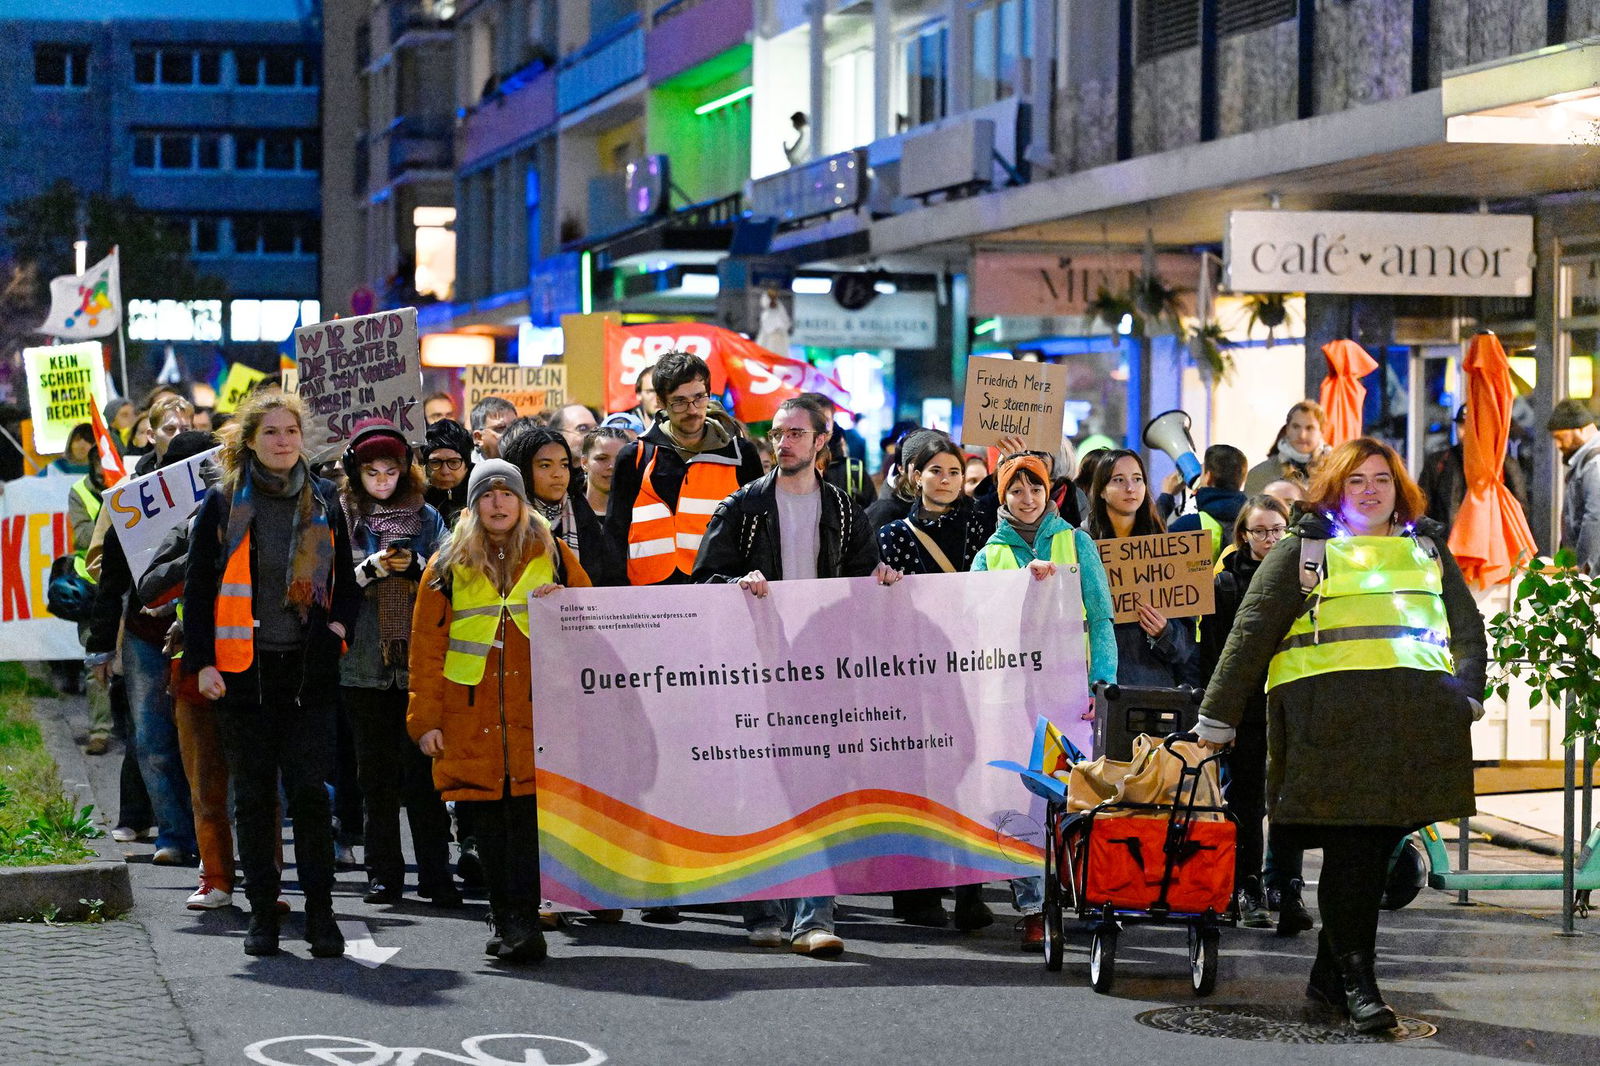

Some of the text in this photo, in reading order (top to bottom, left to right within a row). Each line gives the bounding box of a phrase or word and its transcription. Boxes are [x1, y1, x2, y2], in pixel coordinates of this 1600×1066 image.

[1251, 233, 1510, 278] café amor
[49, 354, 78, 370] KEIN
[40, 369, 91, 388] SCHRITT
[472, 366, 562, 386] NICHT DEIN
[977, 370, 1018, 389] Friedrich
[51, 386, 85, 402] NACH
[982, 392, 999, 409] Sie
[46, 402, 92, 420] RECHTS
[979, 413, 1031, 436] Weltbild
[1120, 533, 1205, 561] SMALLEST
[1133, 563, 1175, 584] WHO
[1150, 584, 1199, 609] LIVED
[560, 612, 698, 622] queerfeministischeskollektiv.wordpress.com
[561, 622, 661, 632] Instagram: queerfemkollektivhd
[581, 648, 1043, 694] Queerfeministisches Kollektiv Heidelberg
[735, 706, 907, 728] Für Chancengleichheit,
[691, 733, 954, 761] Selbstbestimmung und Sichtbarkeit
